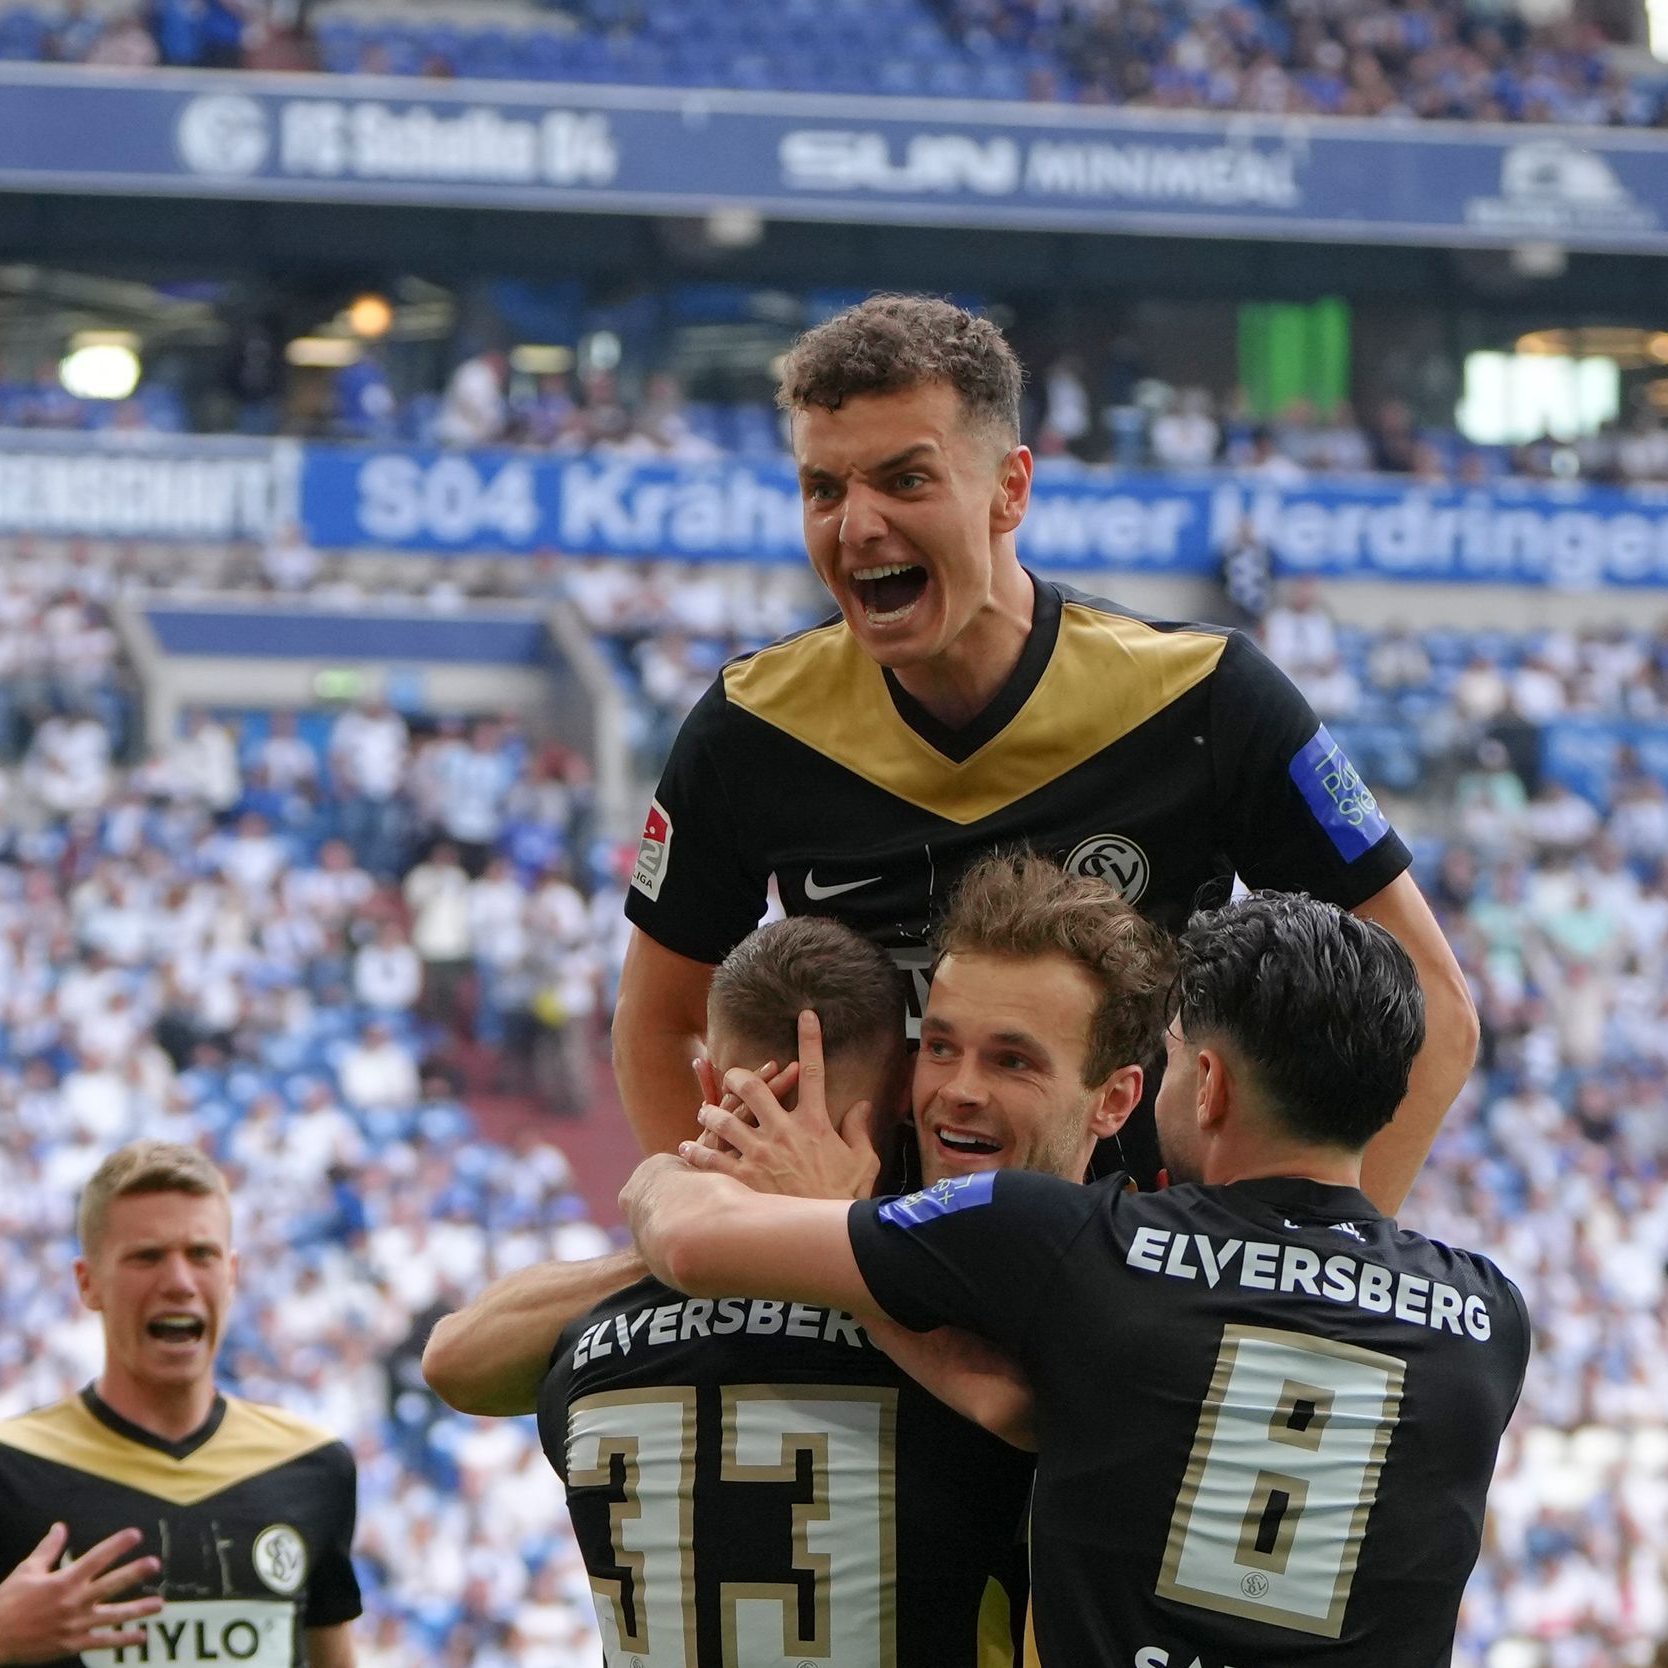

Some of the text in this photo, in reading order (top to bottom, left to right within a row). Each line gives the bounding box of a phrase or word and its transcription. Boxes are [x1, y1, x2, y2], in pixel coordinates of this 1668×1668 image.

[779, 130, 1020, 195] SUN
[358, 456, 536, 541] S04
[559, 460, 810, 553] Kräh
[1126, 1226, 1492, 1342] ELVERSBERG
[572, 1297, 884, 1371] ELVERSBER
[1155, 1323, 1407, 1639] 8
